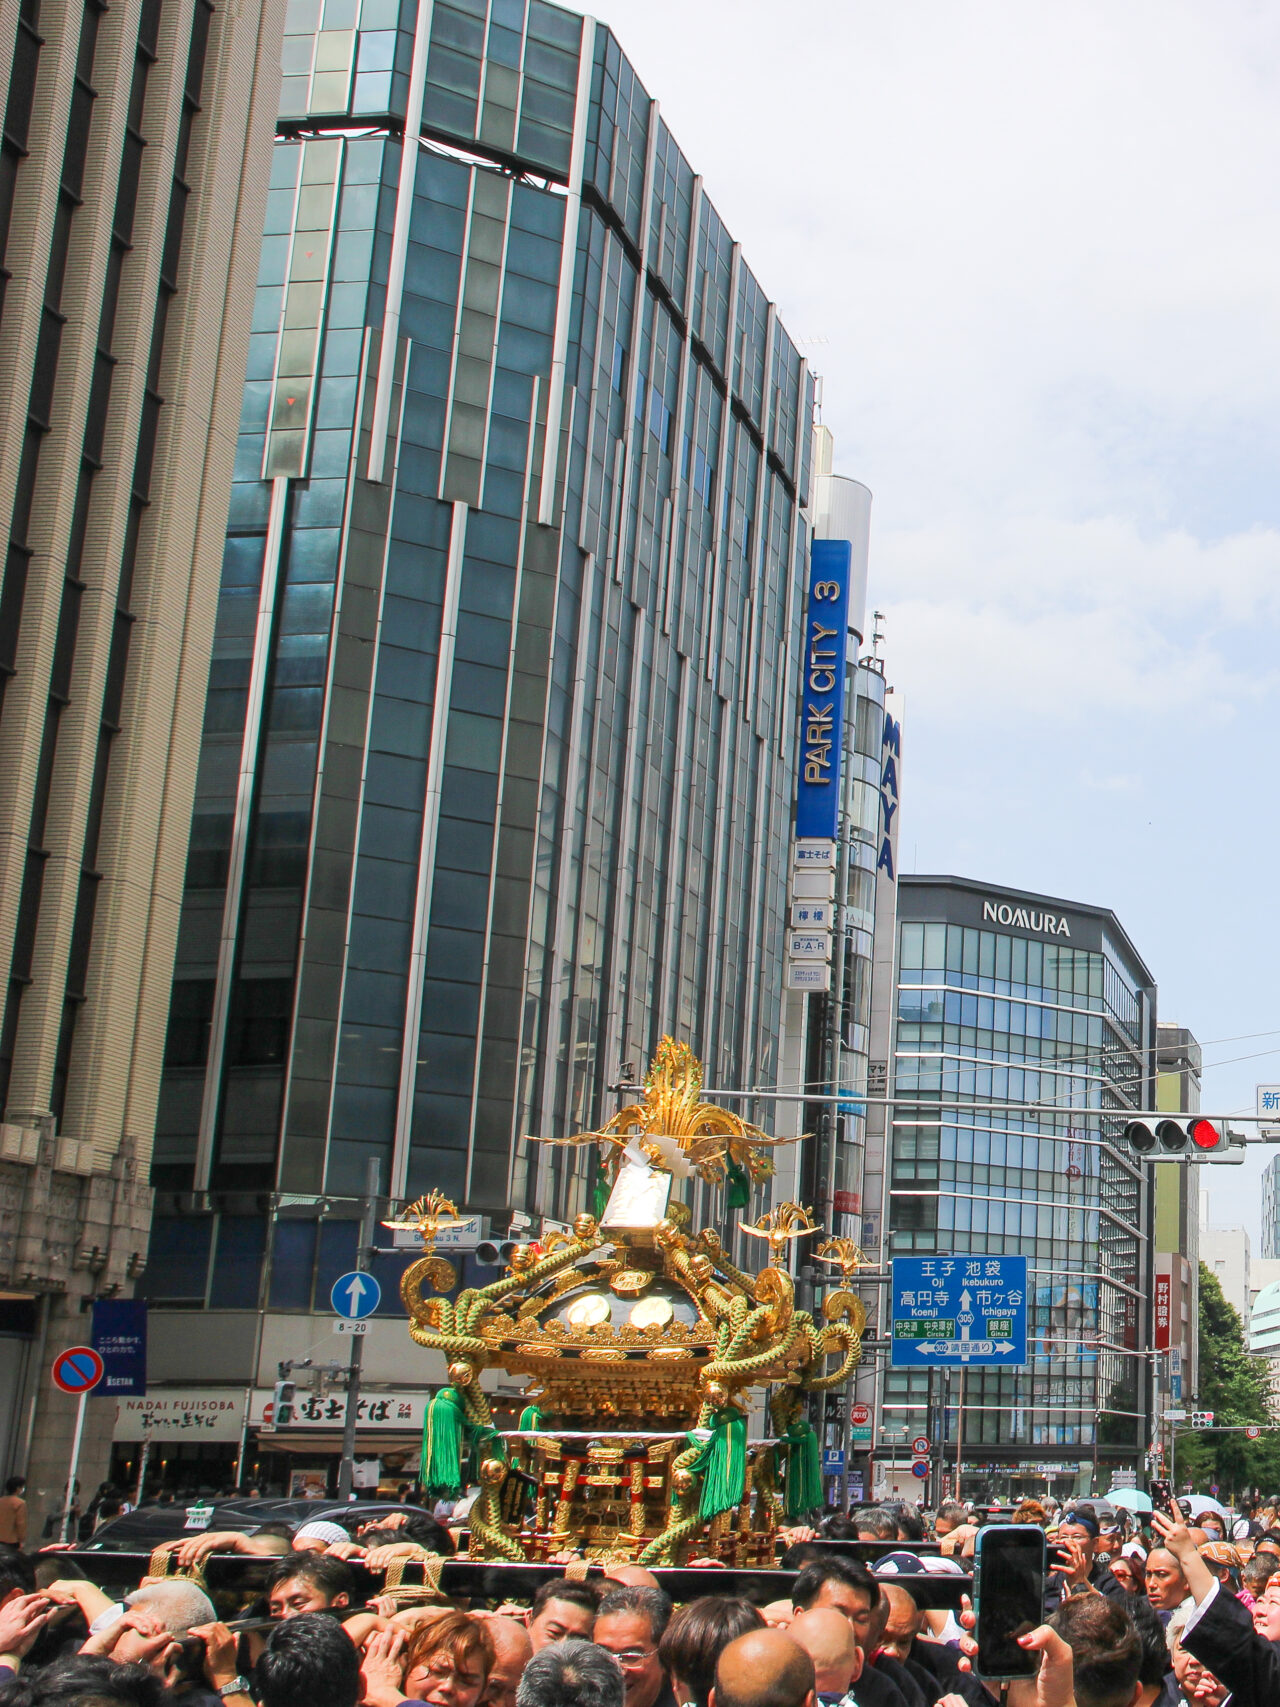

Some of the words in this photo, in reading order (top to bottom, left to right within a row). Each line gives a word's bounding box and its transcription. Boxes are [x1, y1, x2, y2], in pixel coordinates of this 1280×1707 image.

[814, 580, 841, 603] 3
[808, 621, 838, 693] CITY
[803, 703, 835, 785] PARK
[798, 850, 830, 860] 富士そば
[983, 901, 1071, 937] NOMURA
[921, 1261, 956, 1277] 王子
[965, 1260, 1001, 1277] 池袋
[931, 1278, 944, 1288] Oji
[962, 1278, 1004, 1287] Ikebukuro
[900, 1290, 950, 1307] 高円寺
[1158, 1282, 1169, 1328] 野村證券
[911, 1308, 938, 1318] Koenji
[982, 1307, 1017, 1317] Ichigaya
[959, 1314, 972, 1323] 305
[989, 1320, 1009, 1331] 銀座
[126, 1401, 167, 1410] NADAI
[173, 1400, 235, 1411] FUJISOBA
[301, 1397, 395, 1421] 富士そば
[398, 1403, 412, 1412] 24
